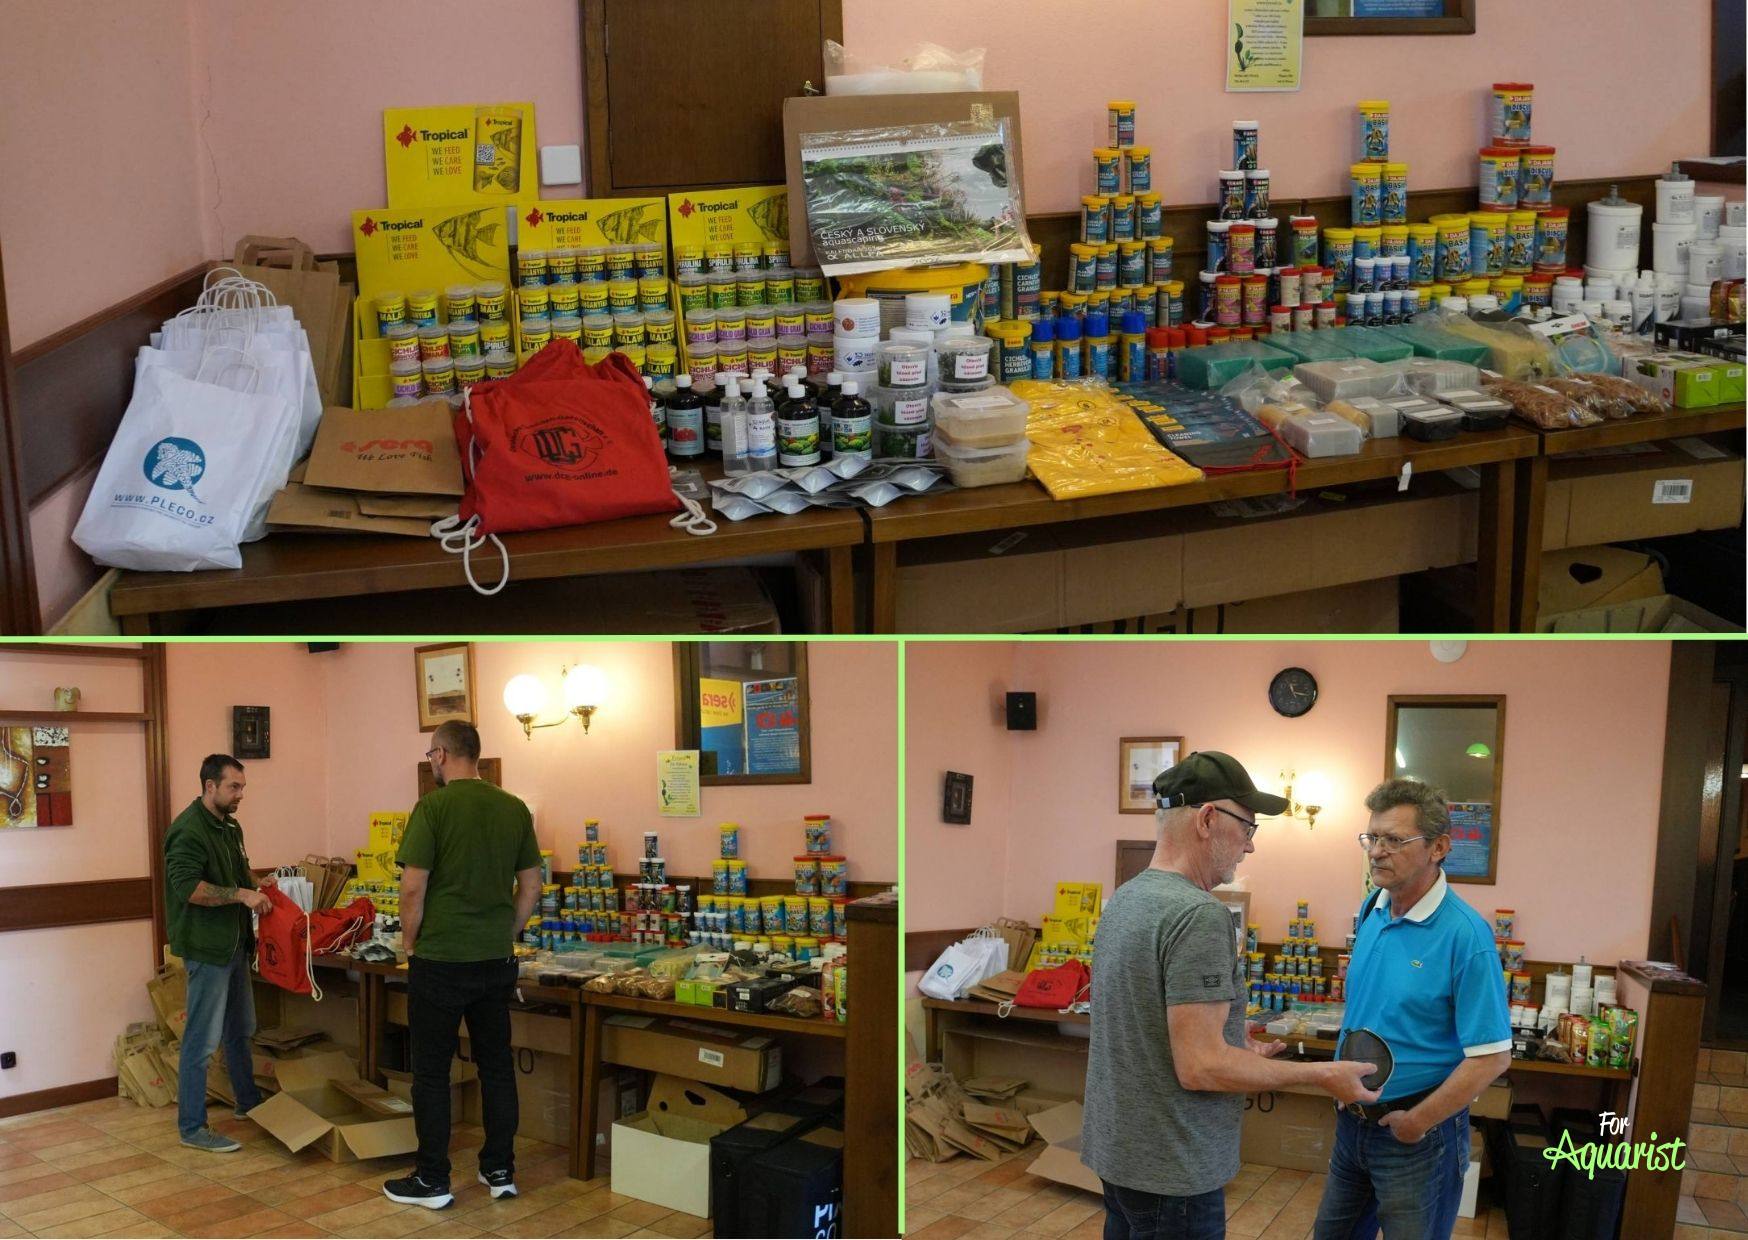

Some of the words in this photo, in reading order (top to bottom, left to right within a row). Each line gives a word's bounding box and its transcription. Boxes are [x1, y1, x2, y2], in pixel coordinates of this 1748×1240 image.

[420, 129, 468, 142] Tropical
[431, 147, 442, 155] WE
[444, 146, 460, 155] FEED
[432, 157, 443, 165] WE
[444, 157, 462, 165] CARE
[433, 168, 443, 176] WE
[445, 168, 462, 176] LOVE
[697, 200, 738, 213] Tropical
[546, 212, 587, 223] Tropical
[380, 219, 423, 231] Tropical
[866, 220, 925, 236] SLOVENSKÝ
[113, 492, 216, 526] www.PLECO.cz
